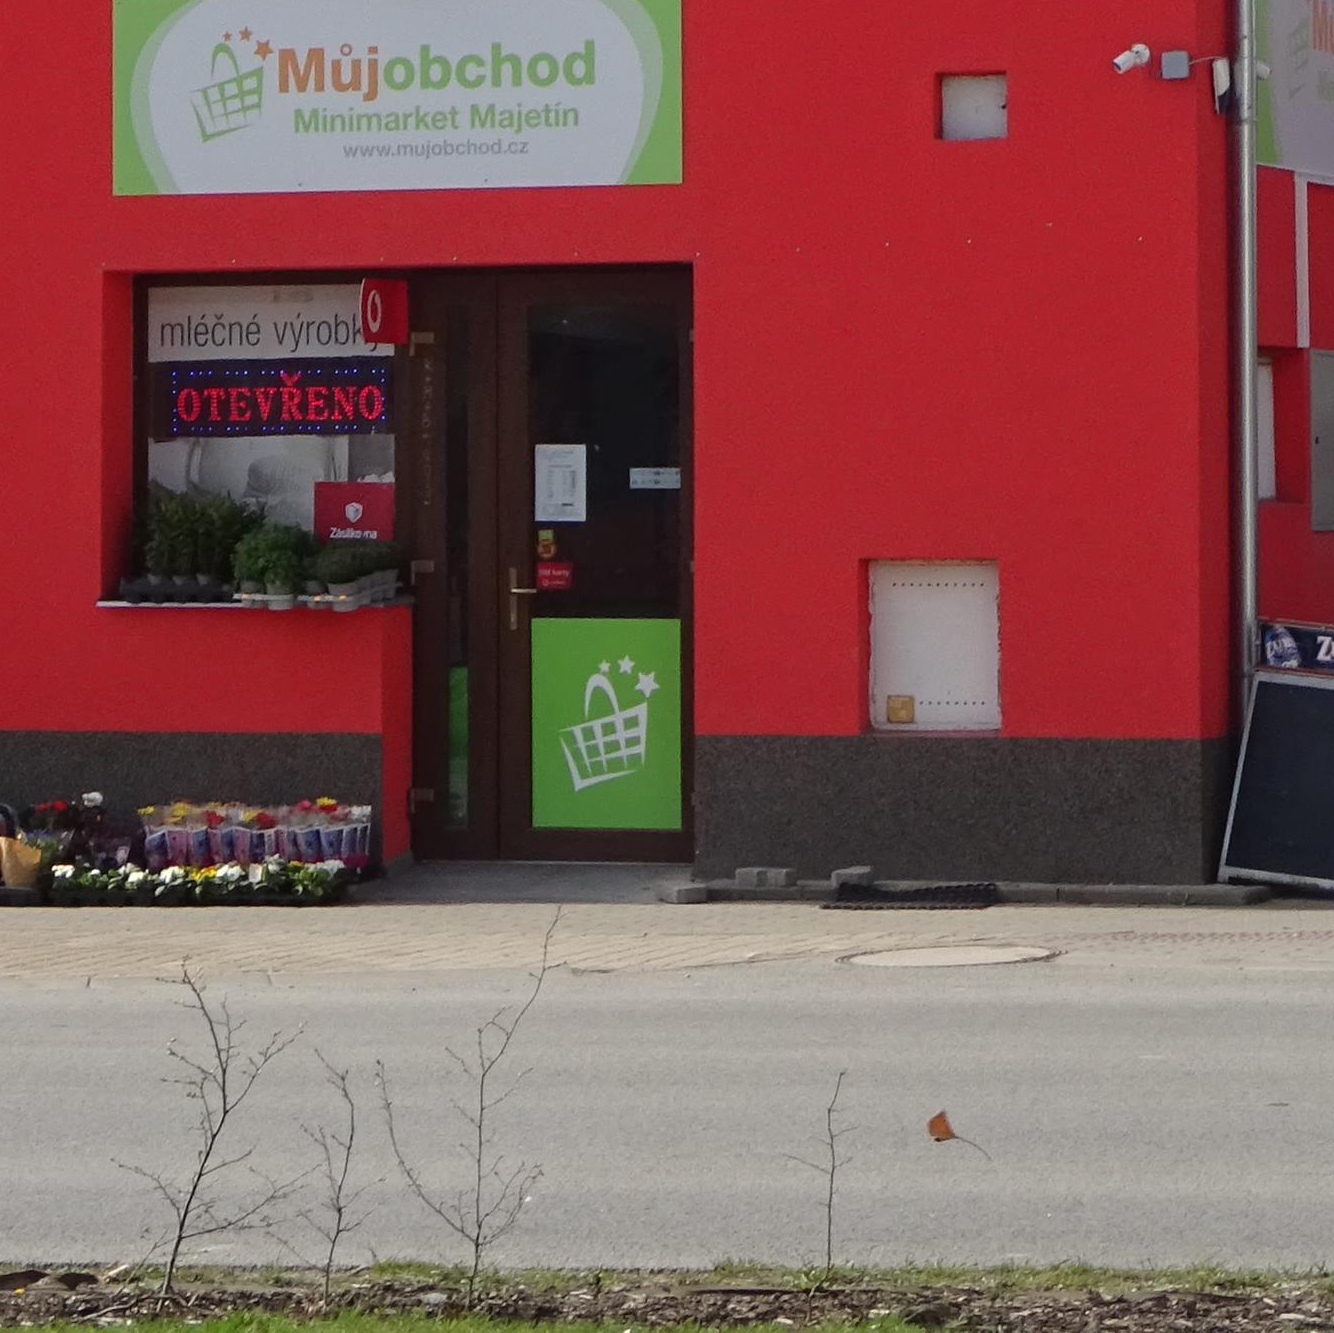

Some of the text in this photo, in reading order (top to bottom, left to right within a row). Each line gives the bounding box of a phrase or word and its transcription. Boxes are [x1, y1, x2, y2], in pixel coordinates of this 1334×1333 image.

[276, 39, 597, 101] Můjobchod
[293, 102, 579, 134] Minimarket Majetín
[342, 138, 529, 160] www.mujobchod.cz
[160, 312, 378, 353] mléčné výrobk
[176, 371, 384, 422] OTEVŘENO
